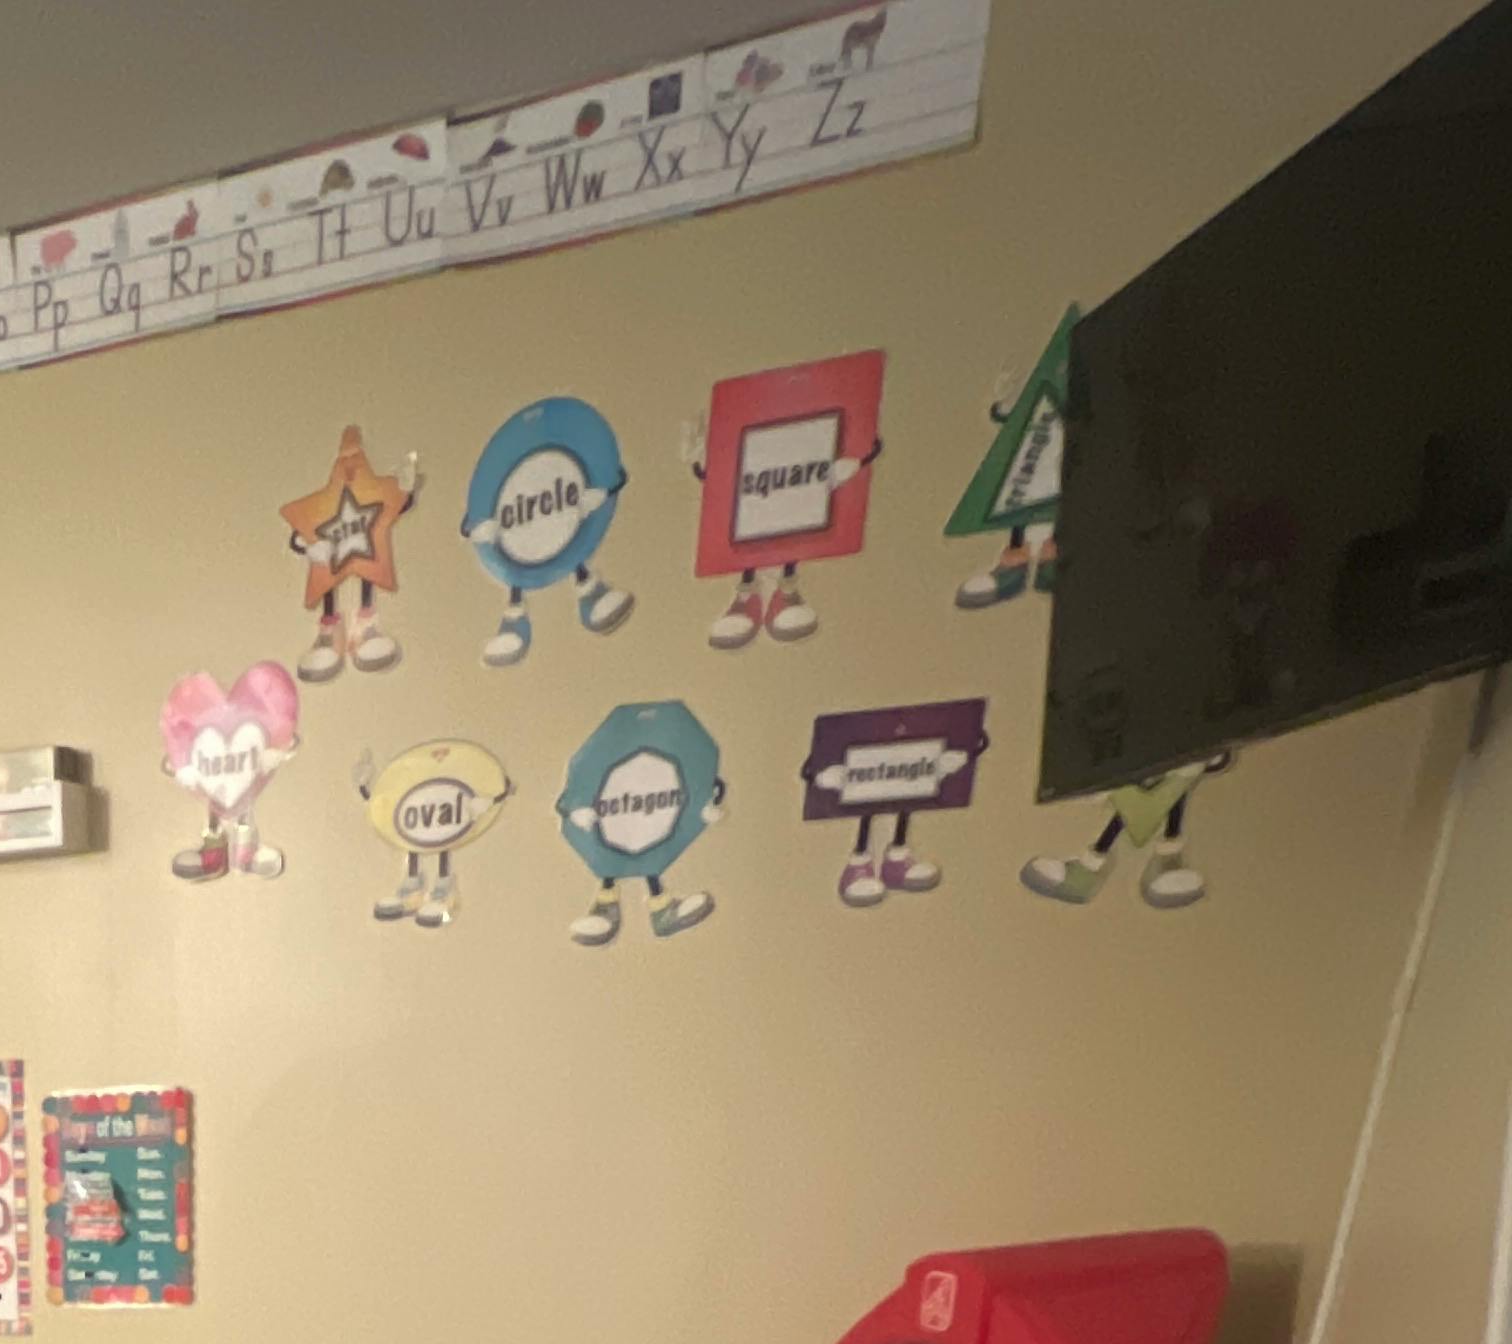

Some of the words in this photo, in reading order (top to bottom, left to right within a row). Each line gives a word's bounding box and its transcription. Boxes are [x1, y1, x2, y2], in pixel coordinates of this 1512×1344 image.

[33, 280, 70, 352] Pp
[99, 264, 142, 332] Qq
[169, 246, 212, 300] Rr
[236, 228, 275, 283] Ss
[310, 204, 353, 265] Tt
[385, 184, 436, 246] Uu
[465, 177, 514, 233] Vv
[544, 151, 607, 214] Ww
[635, 127, 686, 190] Xx
[711, 104, 767, 193] Yy
[810, 77, 867, 147] Zz
[742, 458, 831, 498] square
[500, 477, 580, 530] circle
[332, 516, 369, 543] star
[198, 745, 257, 777] heart
[848, 756, 937, 782] rectangle
[404, 791, 464, 830] oval
[596, 788, 682, 818] octagon
